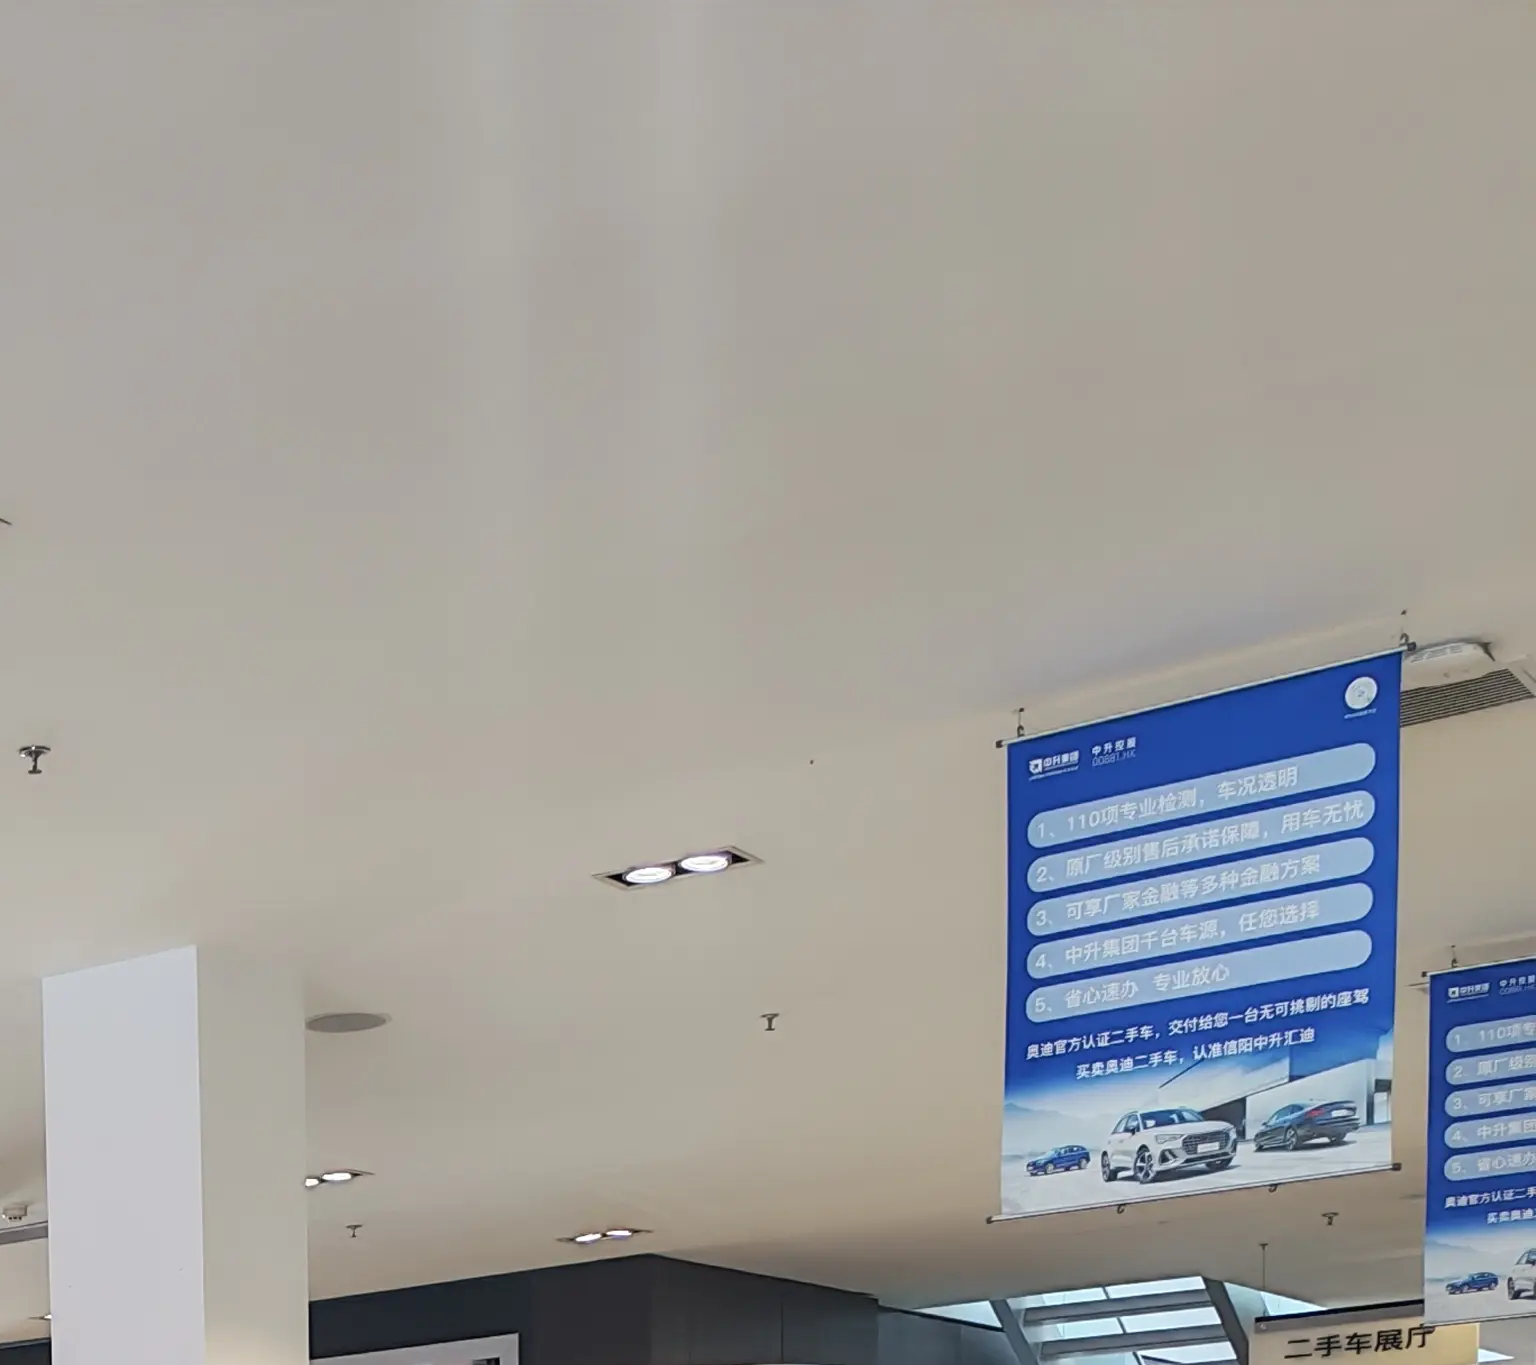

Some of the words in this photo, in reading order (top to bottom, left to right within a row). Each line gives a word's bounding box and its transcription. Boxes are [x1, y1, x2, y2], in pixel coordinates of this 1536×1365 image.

[1283, 1323, 1435, 1360] 二手车展厅
